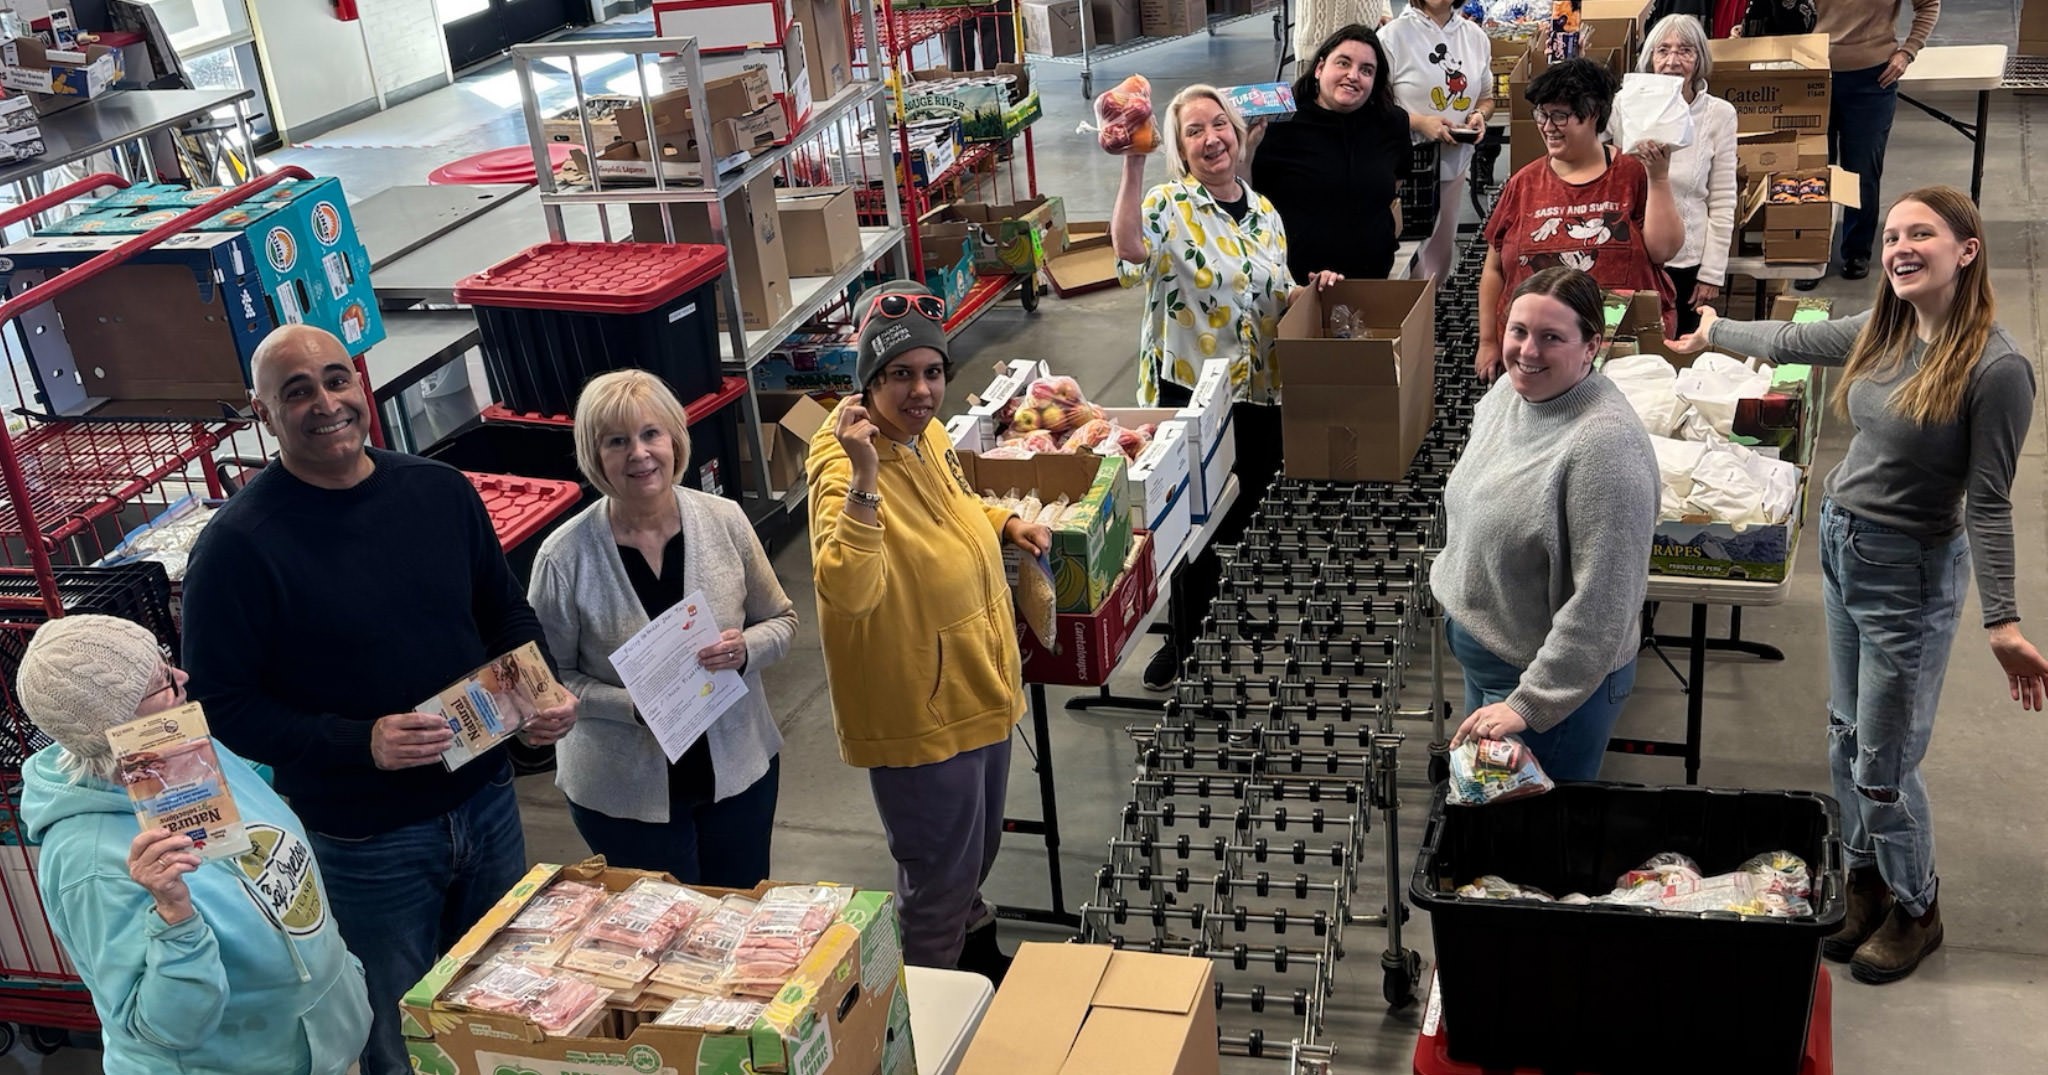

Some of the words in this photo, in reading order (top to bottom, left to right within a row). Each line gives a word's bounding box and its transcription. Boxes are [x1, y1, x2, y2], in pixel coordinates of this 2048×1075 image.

[934, 95, 966, 113] RIVER
[1725, 86, 1777, 103] Catelli
[1534, 206, 1565, 219] SASSY
[1566, 204, 1588, 216] AND
[1589, 201, 1620, 213] SWEET
[315, 205, 332, 246] SUNSET
[269, 230, 287, 272] SUNSET
[785, 374, 852, 385] ORGANIC
[1653, 544, 1702, 558] RAPES
[1074, 621, 1088, 681] Cantaloupes
[450, 698, 480, 742] Natural
[163, 807, 222, 833] Natura
